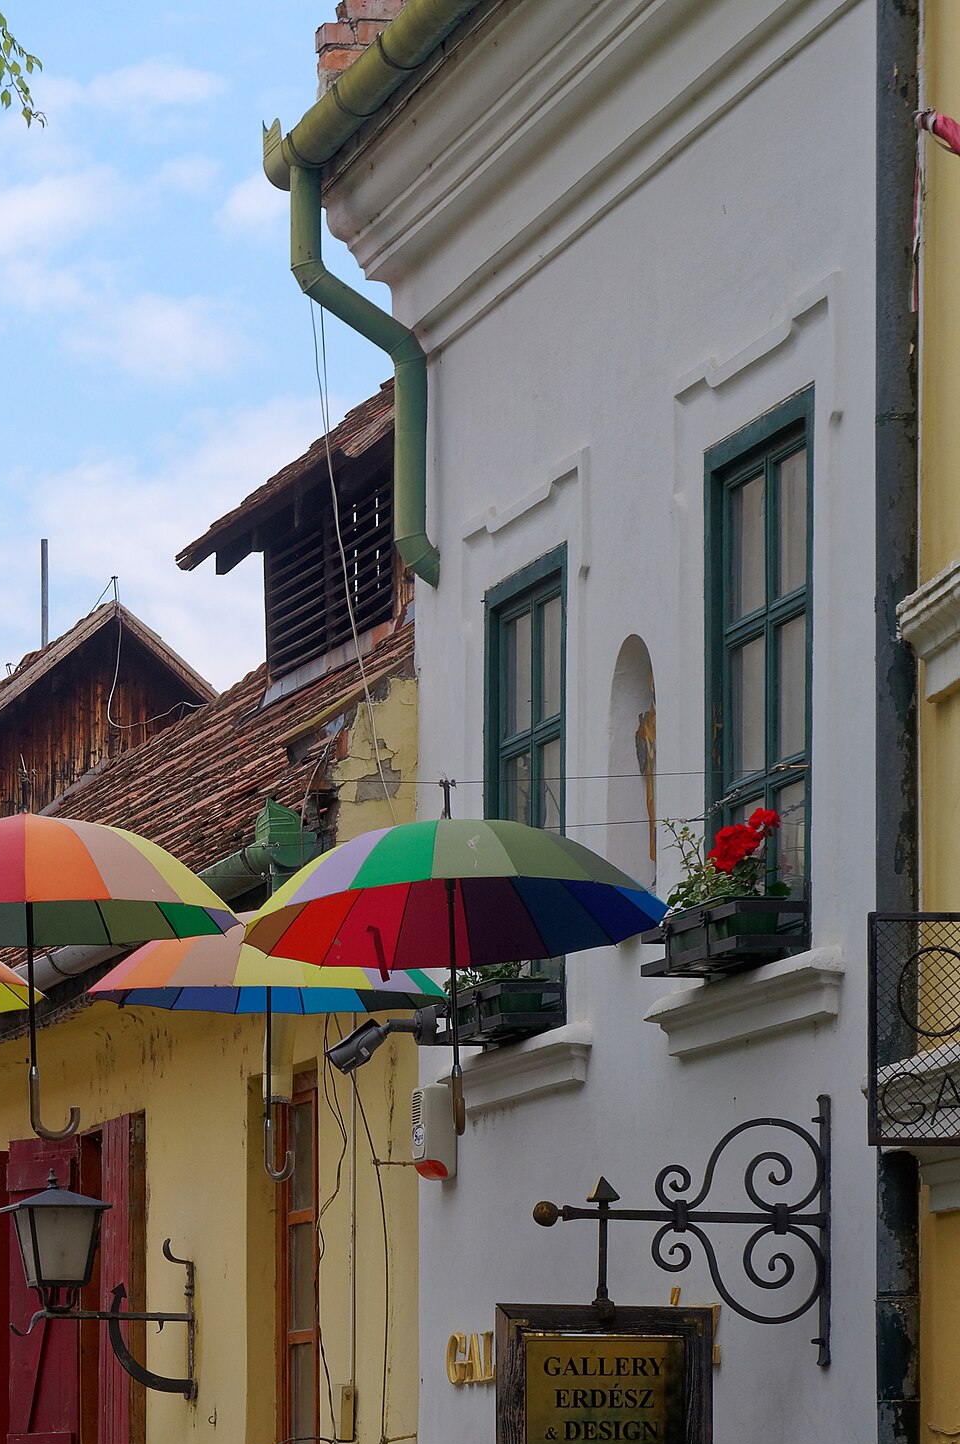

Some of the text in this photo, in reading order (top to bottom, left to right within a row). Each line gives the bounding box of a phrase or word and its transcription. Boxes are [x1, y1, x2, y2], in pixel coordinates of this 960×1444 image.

[543, 1356, 666, 1377] GALLERY
[554, 1384, 655, 1409] ERDÉSZ
[544, 1420, 658, 1441] & DESIGN
